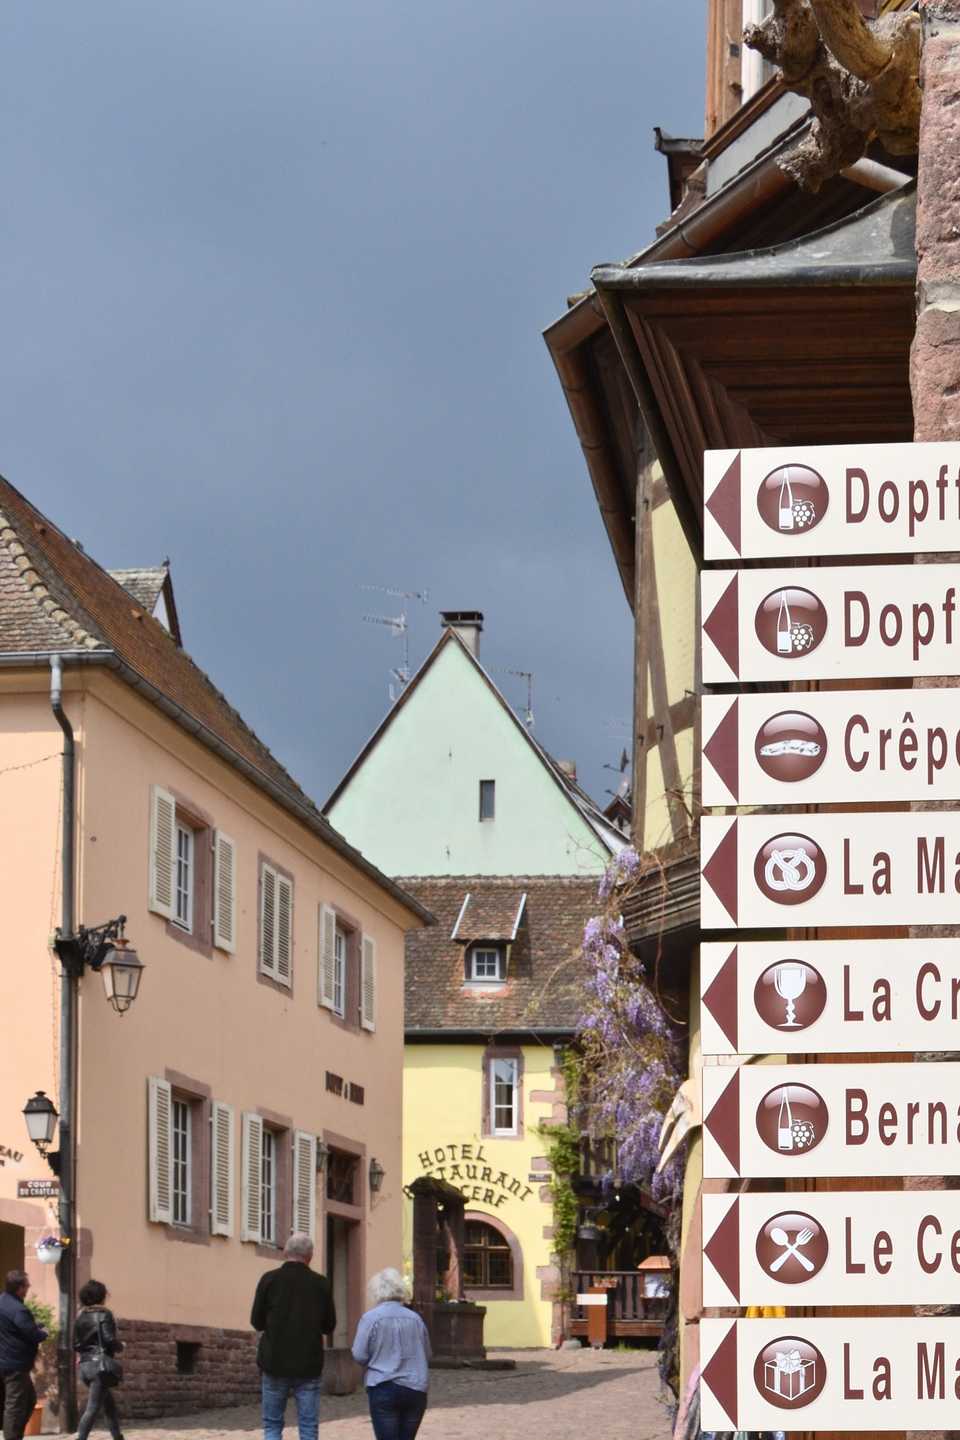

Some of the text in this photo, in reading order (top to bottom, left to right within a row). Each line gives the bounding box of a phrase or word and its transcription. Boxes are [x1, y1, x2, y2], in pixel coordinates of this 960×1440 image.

[843, 838, 892, 896] La
[843, 964, 892, 1022] La
[402, 1163, 534, 1202] RTAURANT
[417, 1143, 487, 1169] HOTEL
[845, 1216, 893, 1275] Le
[843, 1342, 892, 1401] La
